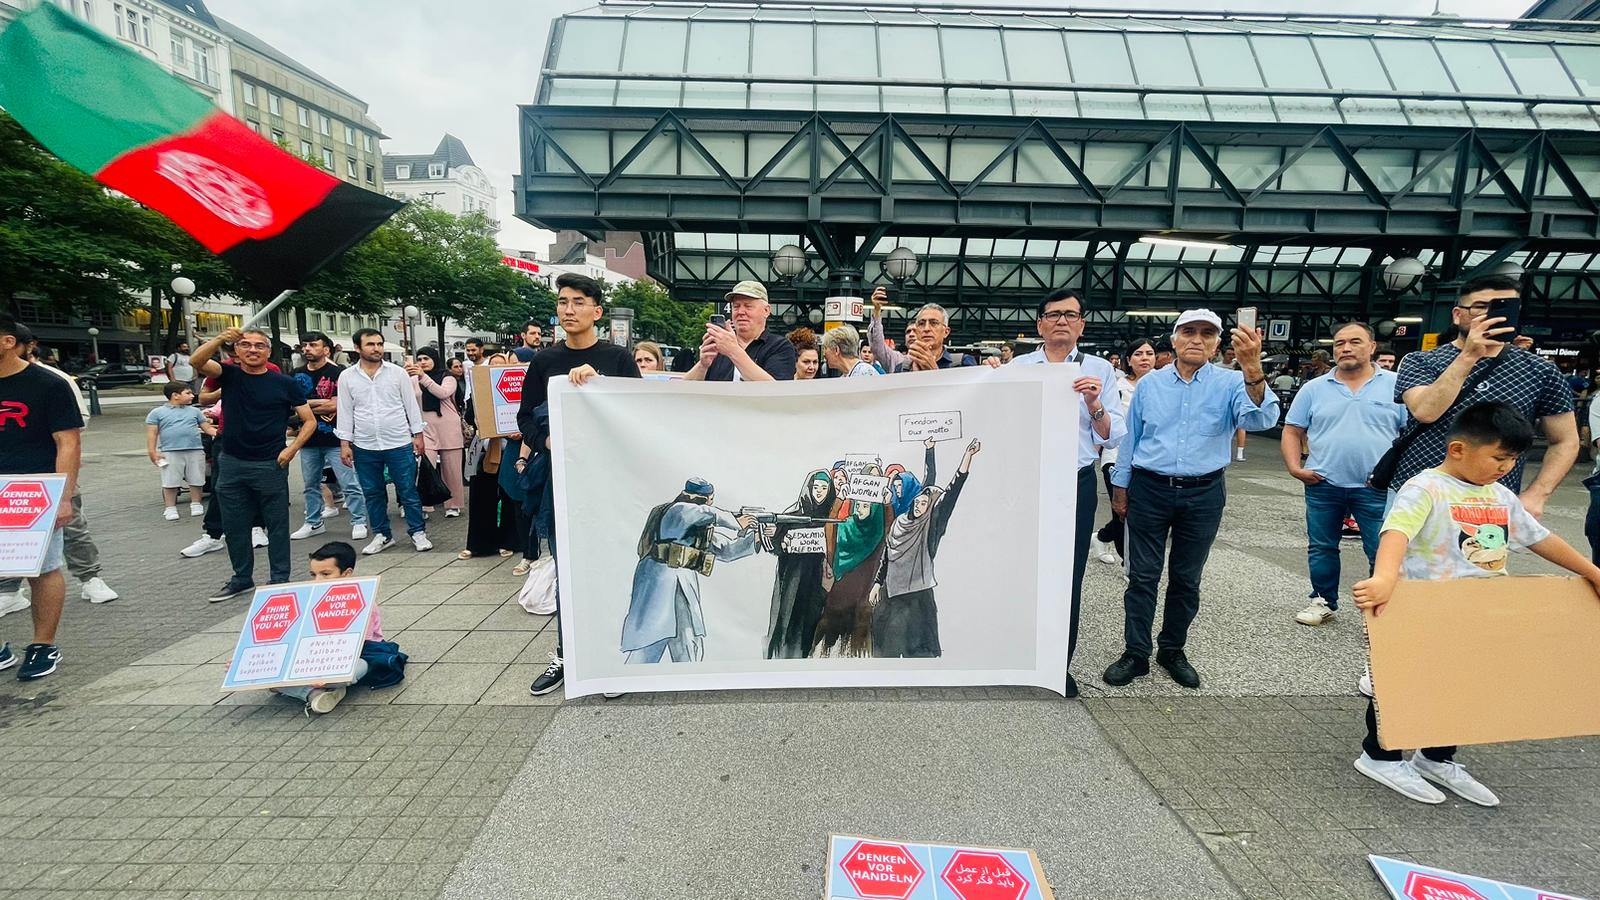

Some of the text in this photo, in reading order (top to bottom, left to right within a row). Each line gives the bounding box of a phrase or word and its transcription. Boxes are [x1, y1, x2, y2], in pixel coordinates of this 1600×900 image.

[1274, 323, 1285, 336] U
[852, 477, 881, 488] AFGAN
[2, 490, 43, 499] DENKEN
[851, 488, 879, 498] WOMEN
[9, 498, 30, 506] VOR
[324, 592, 358, 603] DENKEN
[265, 604, 291, 614] THINK
[329, 602, 346, 610] VOR
[259, 612, 290, 623] BEFORE
[317, 608, 357, 619] HANDELN
[254, 621, 272, 630] YOU
[857, 851, 908, 865] DENKEN
[867, 862, 893, 873] VOR
[852, 869, 914, 884] HANDELN
